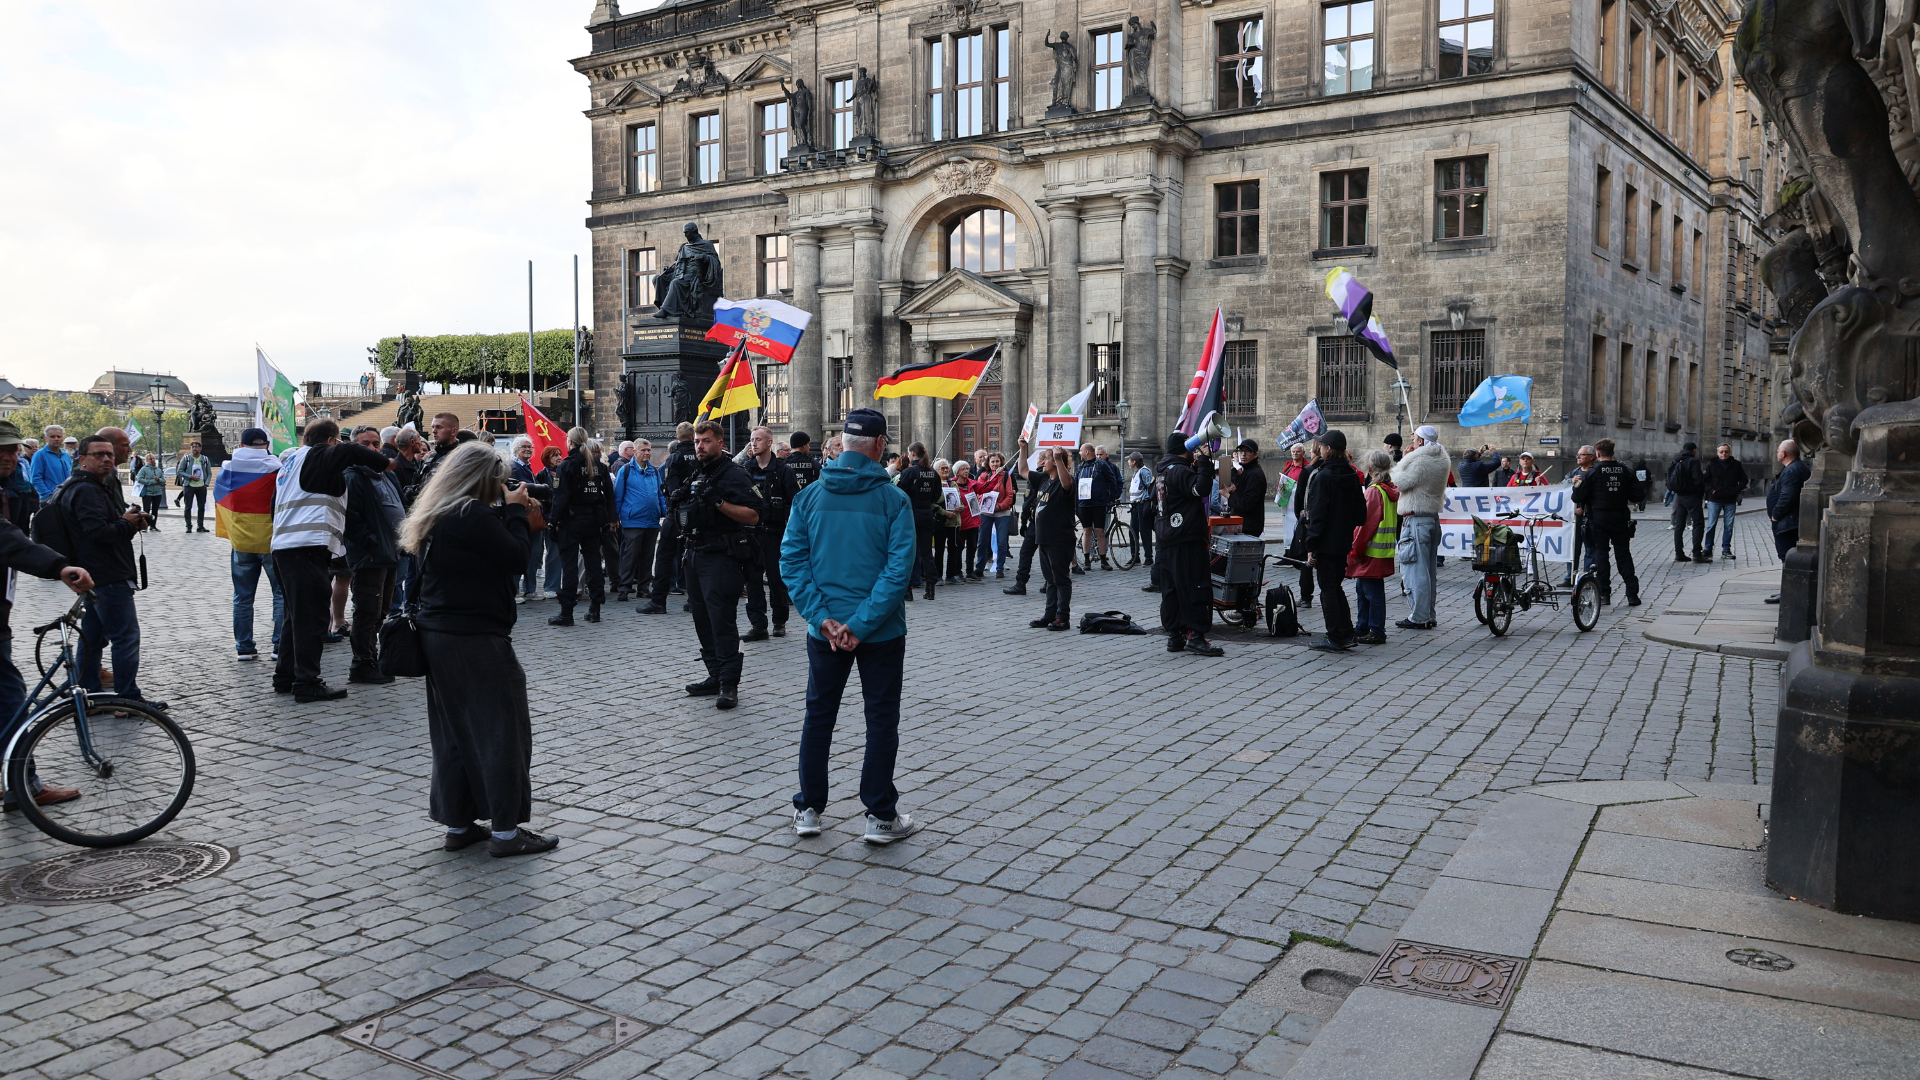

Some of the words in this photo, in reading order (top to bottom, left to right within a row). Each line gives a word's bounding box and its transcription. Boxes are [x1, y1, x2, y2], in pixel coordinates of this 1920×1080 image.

[1601, 466, 1623, 474] POLIZEI
[919, 471, 935, 479] POLIZEI
[1522, 491, 1564, 513] ZU
[875, 823, 893, 831] HOKA
